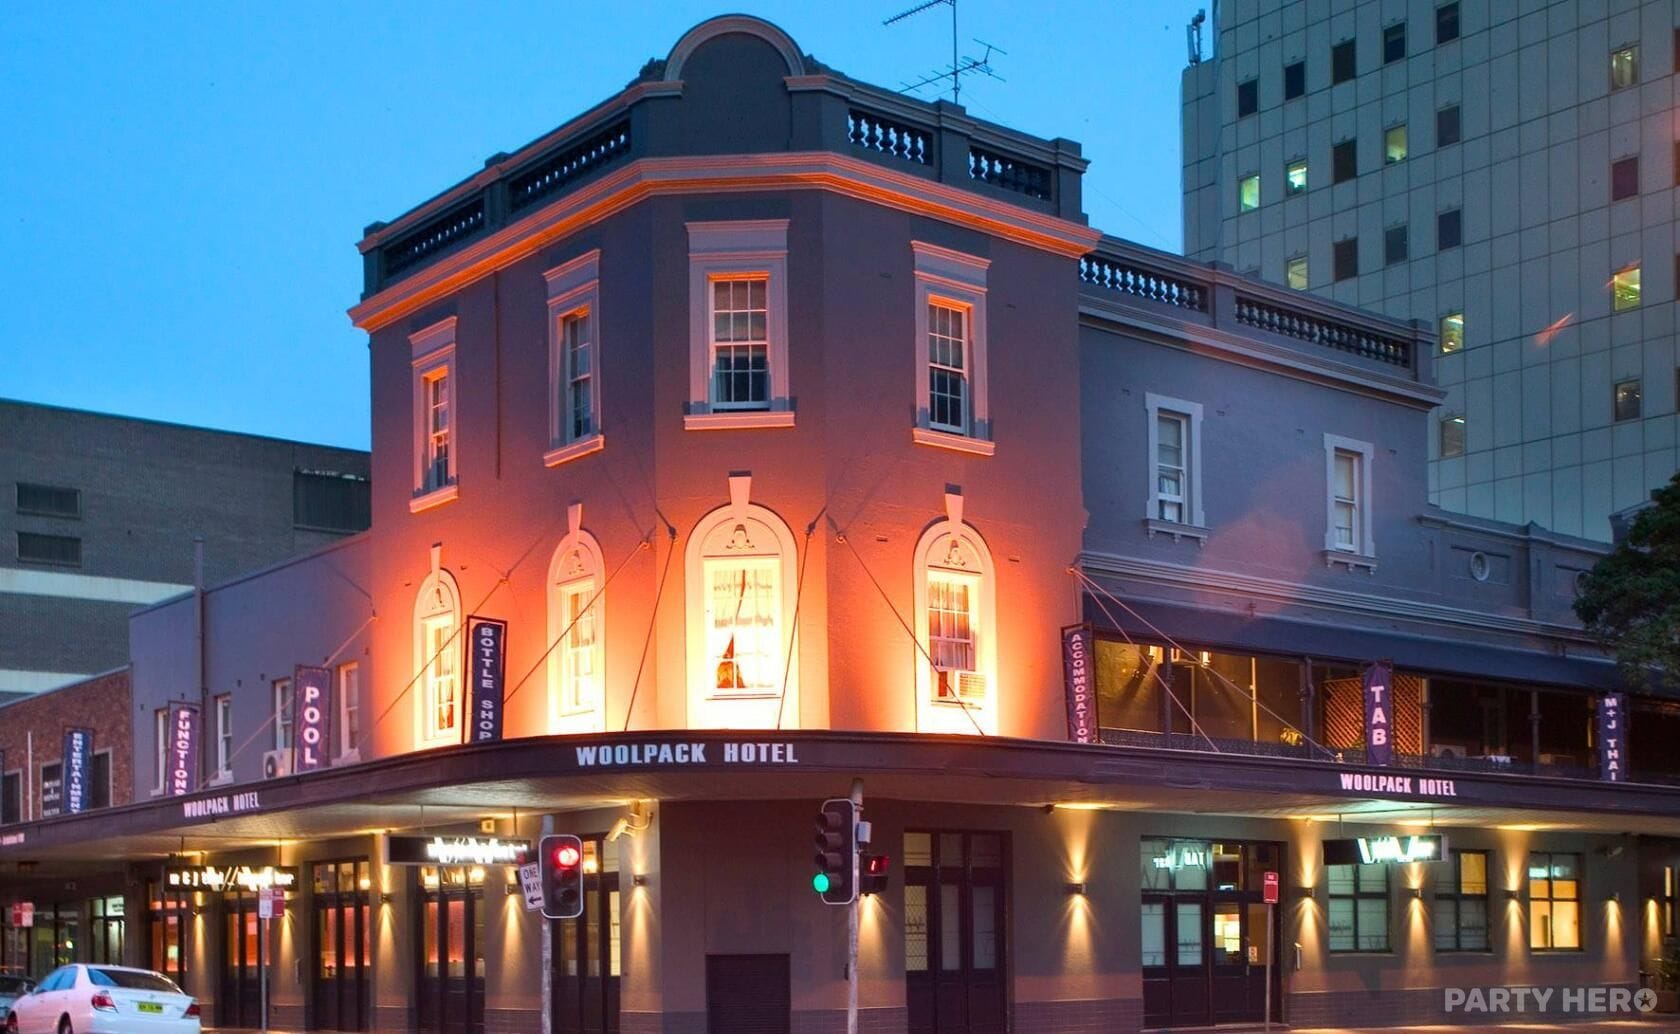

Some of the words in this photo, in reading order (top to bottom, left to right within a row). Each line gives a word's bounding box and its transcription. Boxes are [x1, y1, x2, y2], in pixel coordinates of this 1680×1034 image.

[480, 627, 495, 689] BOTTLE
[1072, 634, 1088, 743] ACCOMMODATION
[303, 686, 320, 764] POOL
[479, 700, 494, 740] SHOP
[1371, 685, 1387, 745] TAB
[576, 743, 706, 766] WOOLPACK
[724, 743, 799, 763] HOTEL
[1606, 738, 1619, 781] THAI
[183, 797, 229, 818] WOOLPACK
[233, 791, 260, 811] HOTEL
[1340, 773, 1412, 794] WOOLPACK
[1419, 778, 1457, 796] HOTEL
[523, 865, 538, 880] ONE
